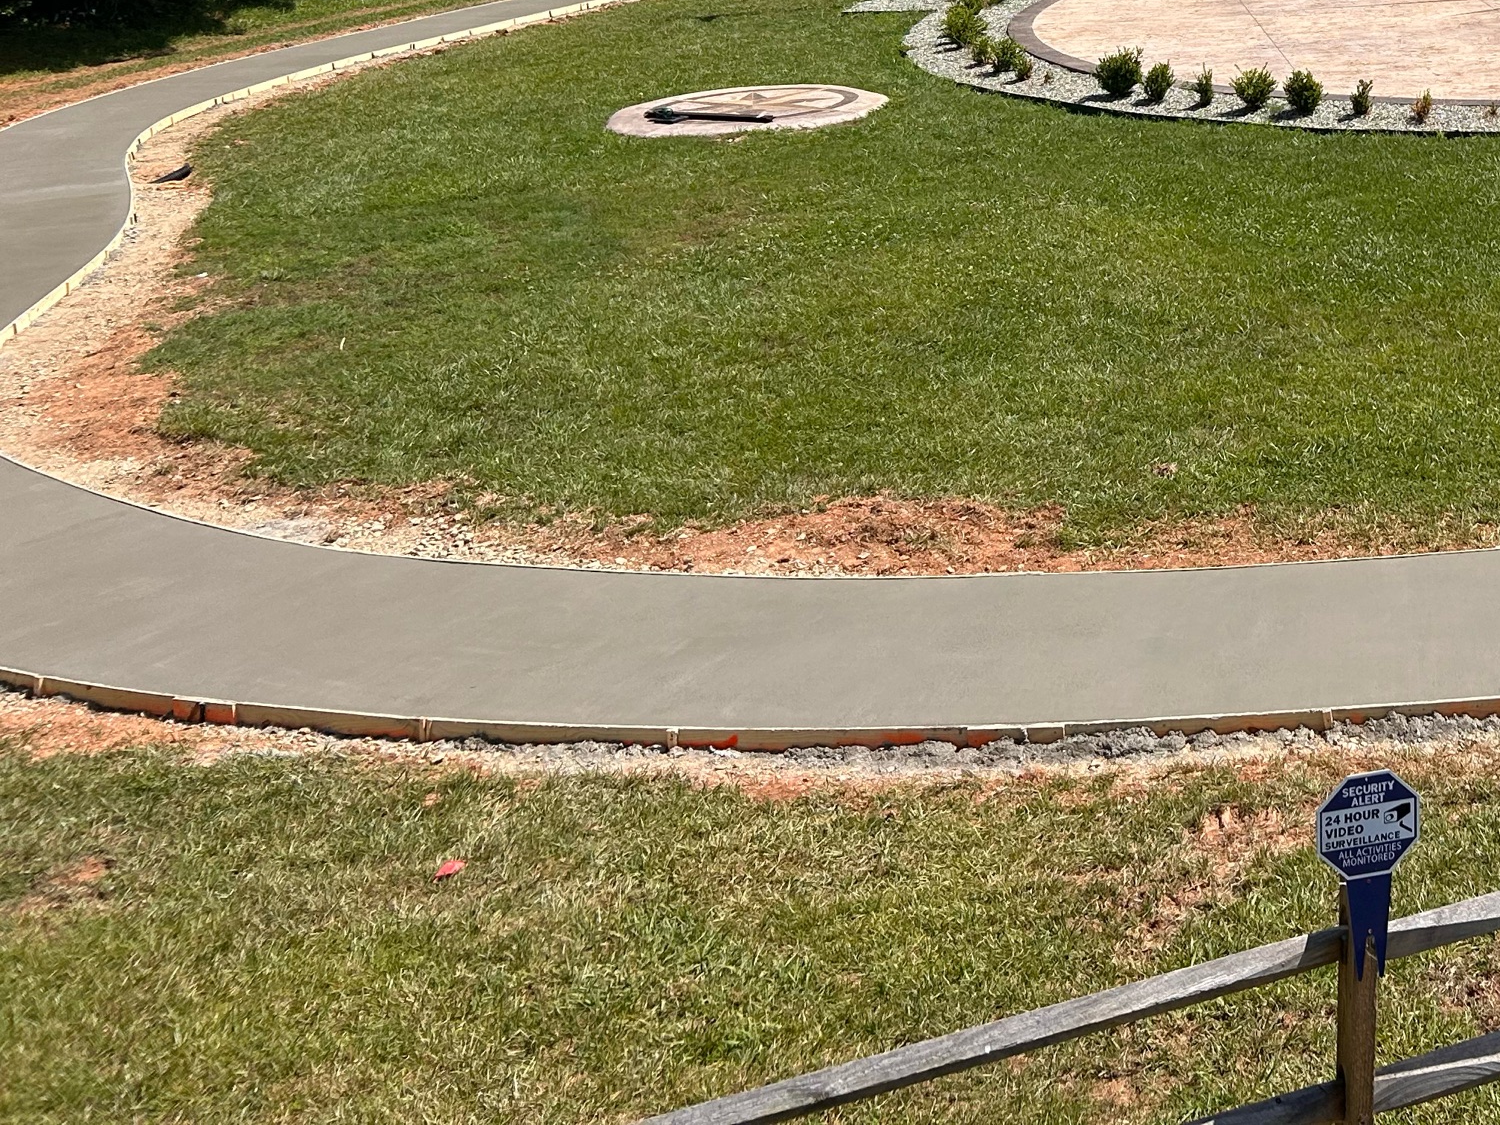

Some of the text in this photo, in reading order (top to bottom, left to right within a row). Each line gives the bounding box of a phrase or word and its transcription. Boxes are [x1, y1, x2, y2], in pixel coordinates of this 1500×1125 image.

[1342, 780, 1395, 798] SECURITY
[1351, 793, 1385, 807] ALERT
[1325, 808, 1380, 827] 24 HOUR
[1325, 824, 1364, 839] VIDEO
[1325, 831, 1400, 850] SURVEILLANCE
[1339, 841, 1402, 860] ALL ACTIVITIES
[1342, 852, 1395, 867] MONITORED
